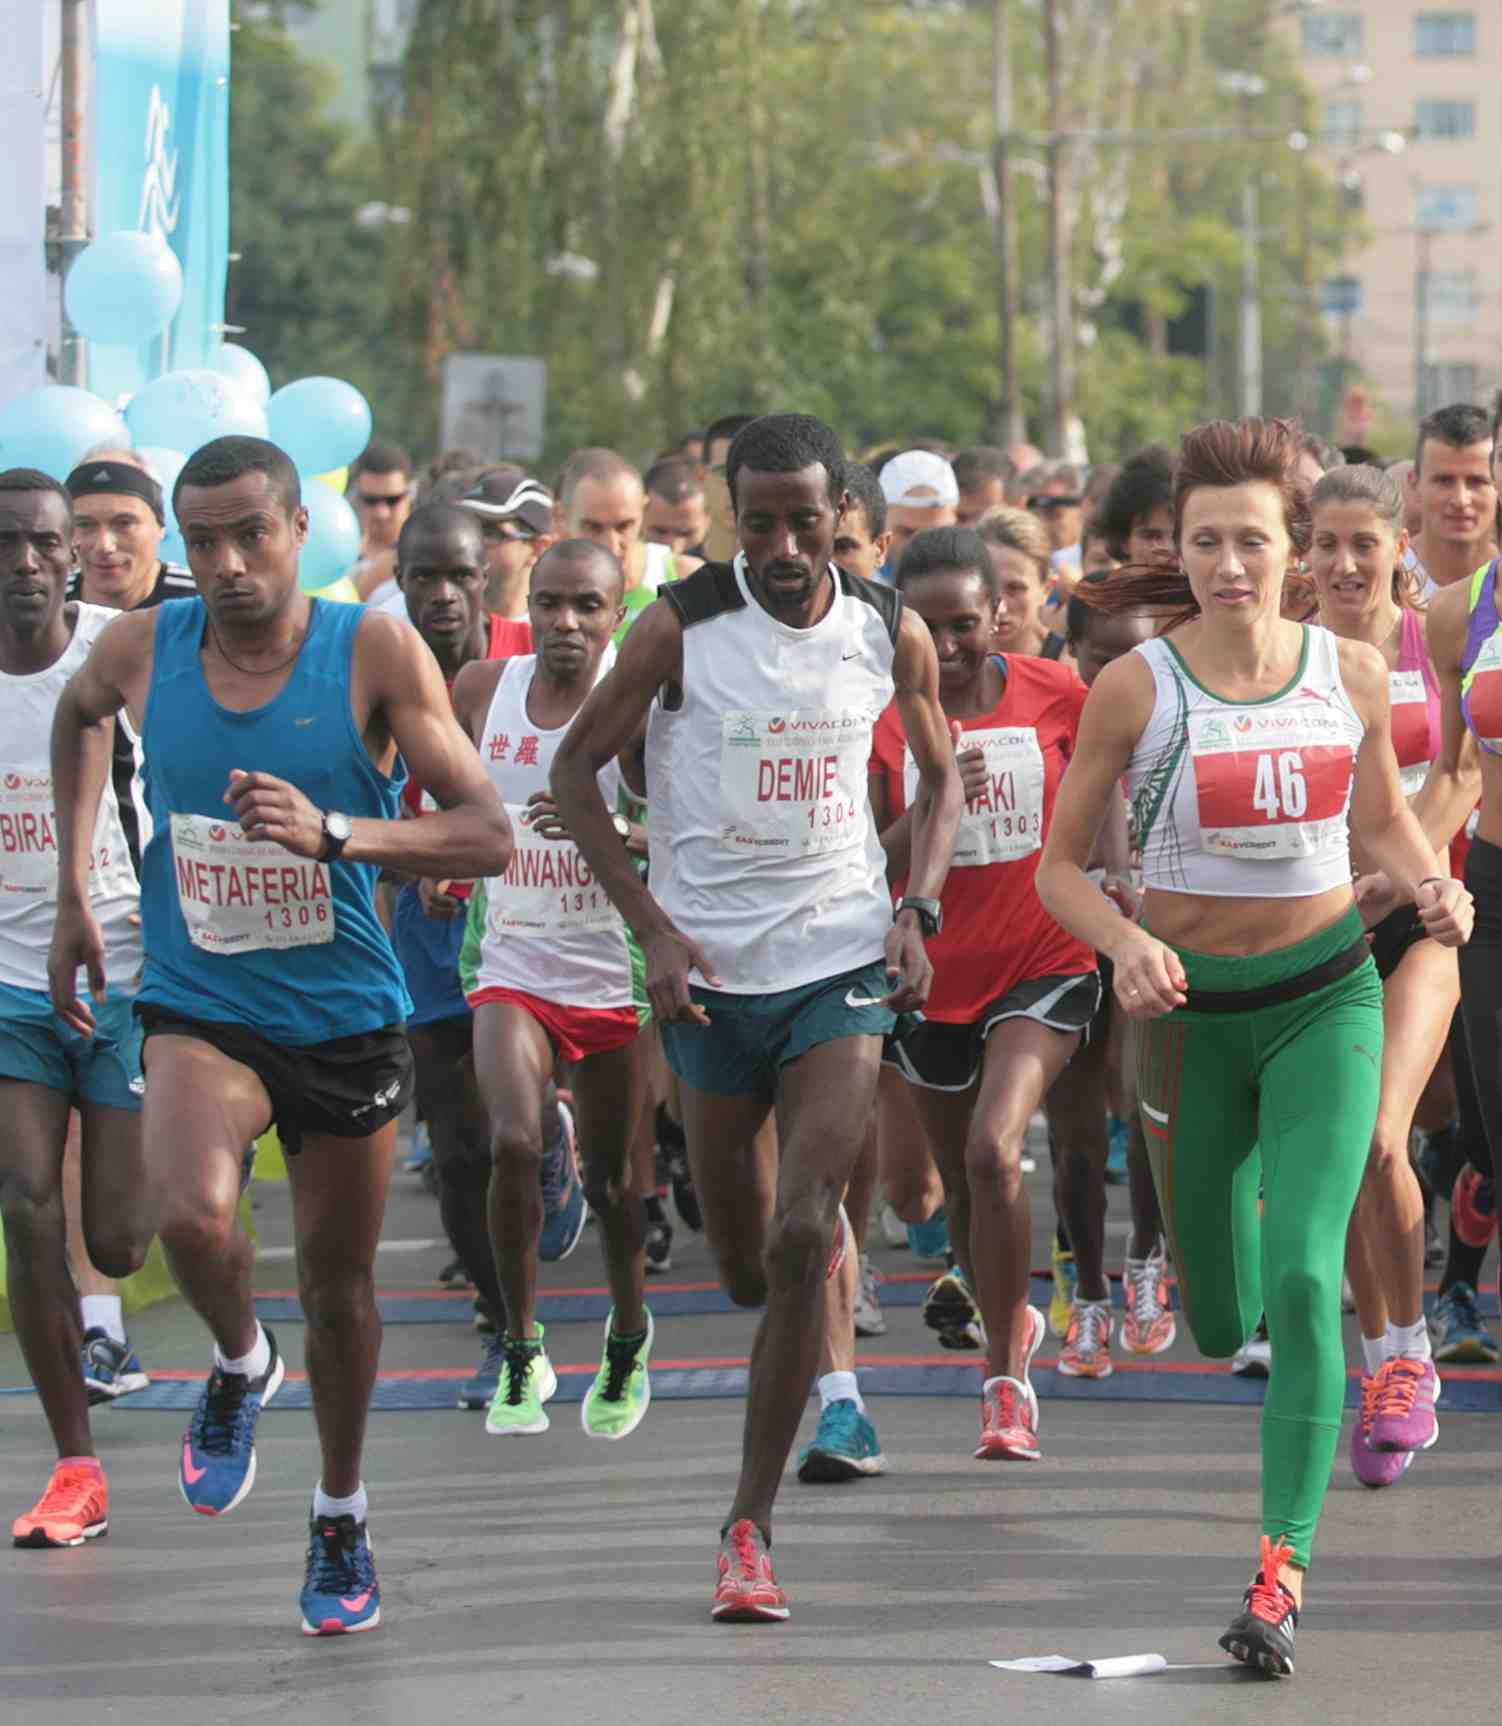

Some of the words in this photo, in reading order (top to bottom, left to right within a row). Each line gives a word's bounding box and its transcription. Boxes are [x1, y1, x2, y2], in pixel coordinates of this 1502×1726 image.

[757, 755, 839, 802] DEMIE
[1253, 751, 1308, 820] 46
[990, 812, 1040, 839] 1303
[176, 855, 331, 908] METAFERIA
[264, 903, 328, 929] 1306
